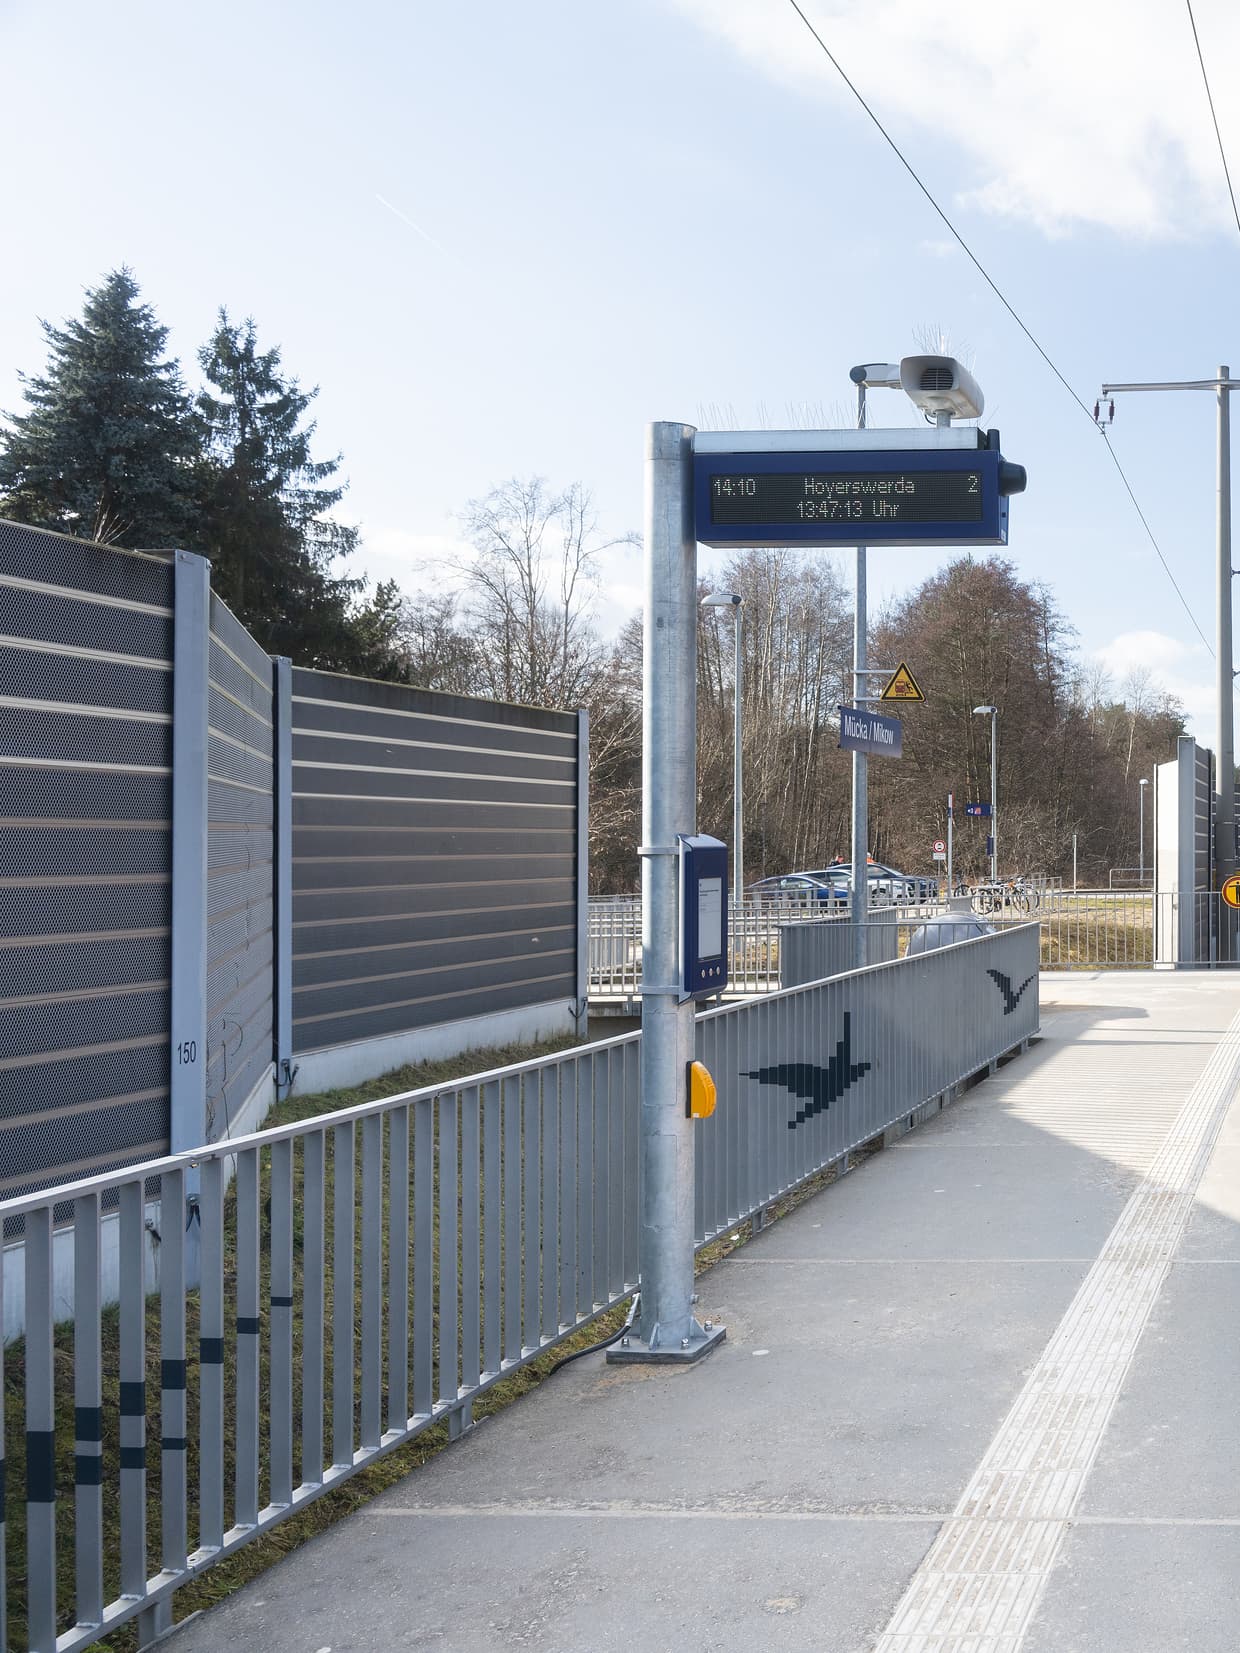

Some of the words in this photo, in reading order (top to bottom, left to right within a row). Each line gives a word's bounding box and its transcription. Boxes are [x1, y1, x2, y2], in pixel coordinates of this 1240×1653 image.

[713, 478, 756, 496] 14:10
[804, 476, 915, 498] Hoyerswerda
[967, 475, 978, 493] 2
[797, 500, 862, 518] 13:47:13
[872, 500, 899, 518] Uhr
[844, 715, 867, 740] Mücka
[873, 721, 894, 745] Mikow
[177, 1040, 197, 1065] 150
